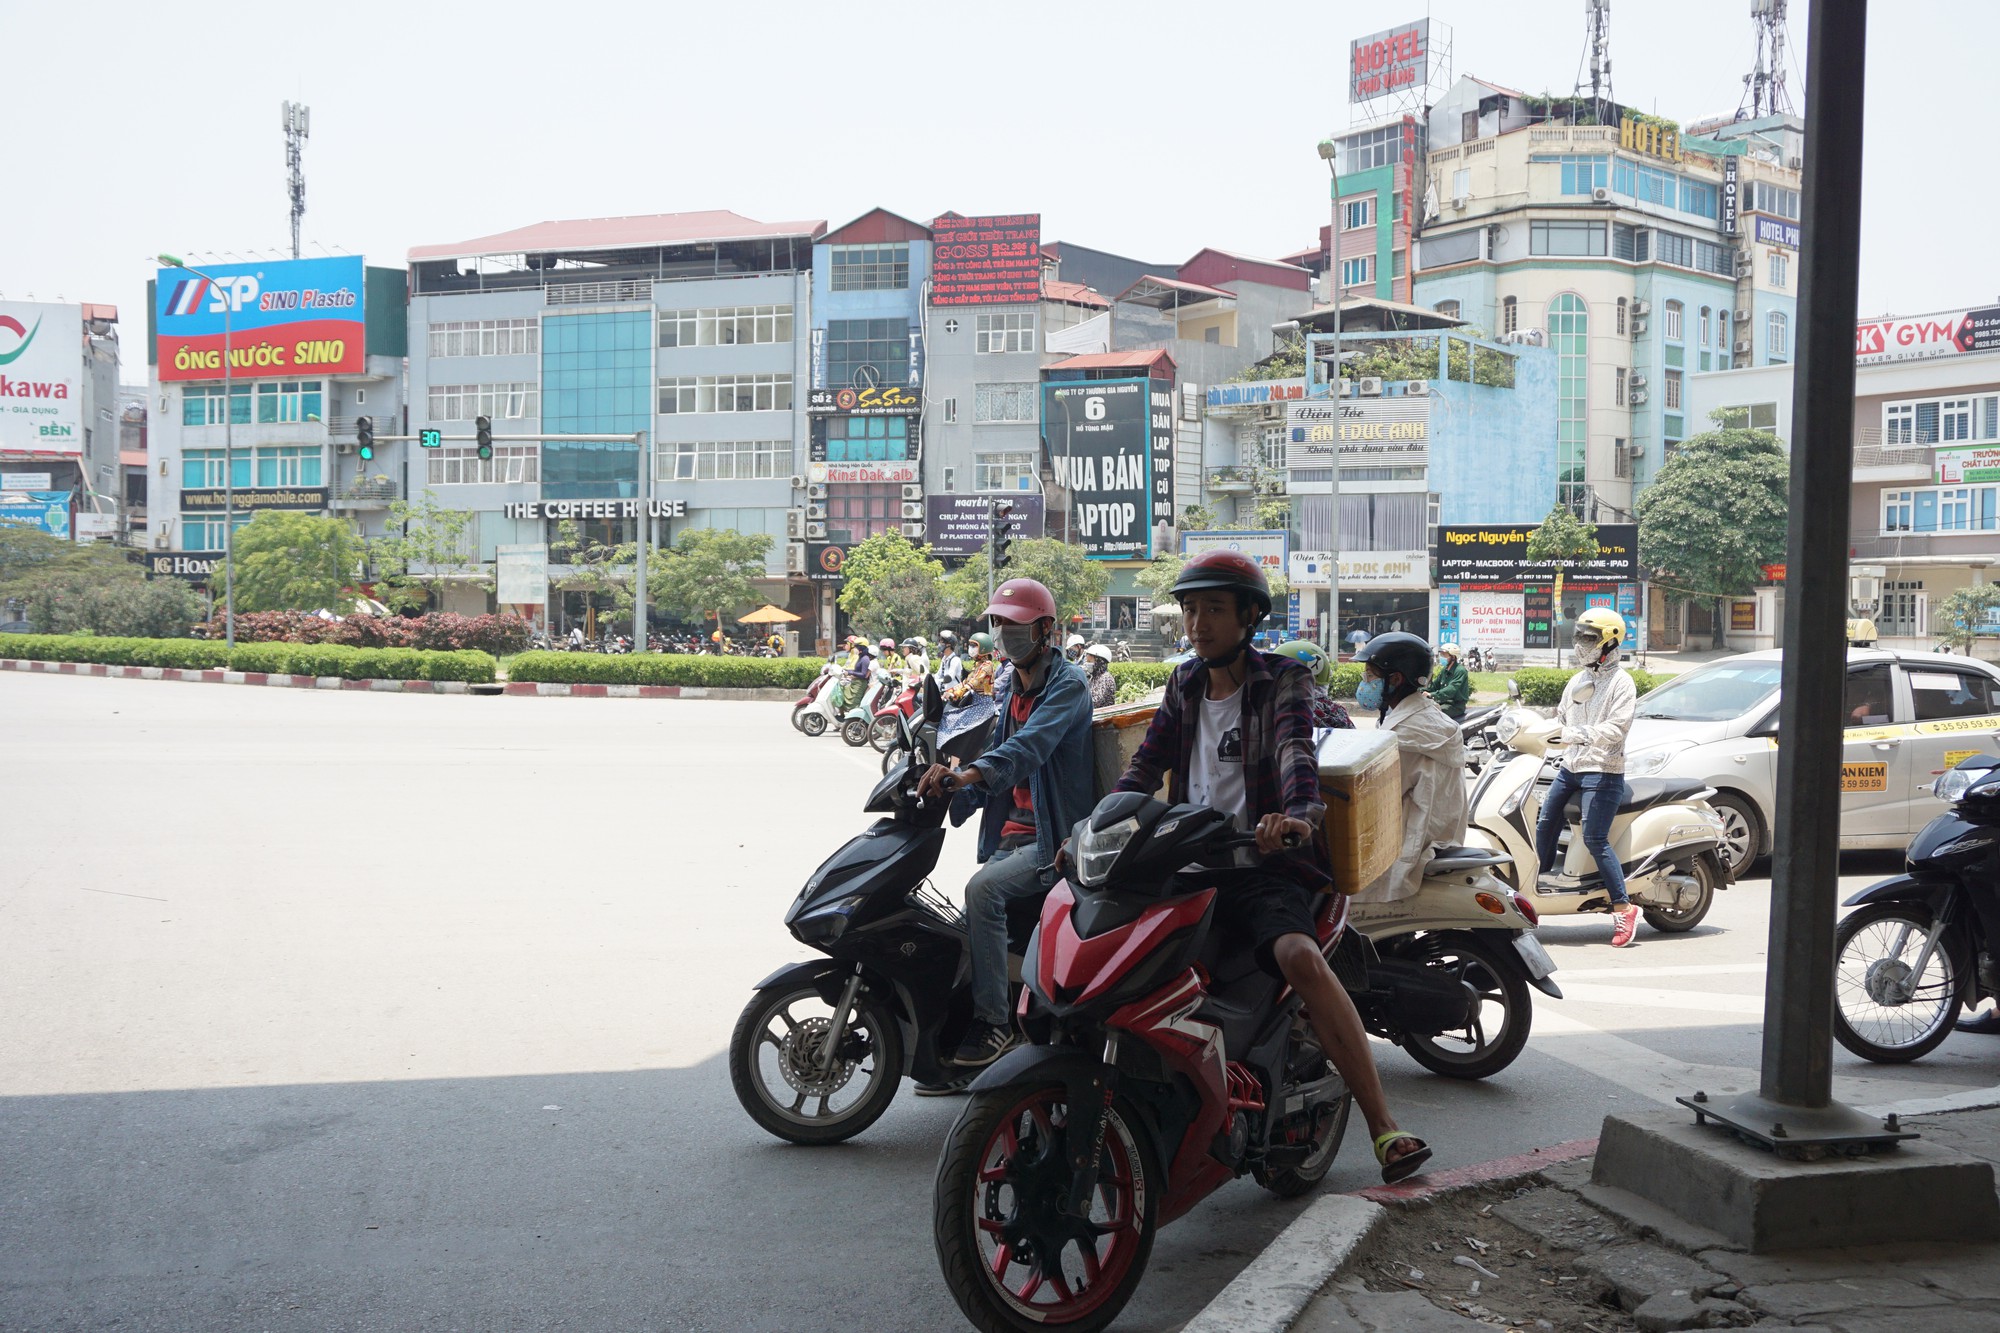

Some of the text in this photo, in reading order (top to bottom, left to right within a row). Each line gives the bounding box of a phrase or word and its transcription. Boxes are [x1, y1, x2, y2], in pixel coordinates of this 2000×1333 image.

[1355, 29, 1423, 77] HOTEL
[1621, 117, 1683, 161] HOTEL
[1403, 126, 1415, 226] HOTEL
[1726, 171, 1736, 232] HOTEL
[1005, 229, 1039, 239] TRANG
[1760, 220, 1784, 242] HOTEL
[936, 244, 989, 259] GOSS
[209, 275, 259, 313] SP
[260, 287, 356, 311] SINO Plastic
[1896, 319, 1953, 346] GYM
[174, 340, 345, 370] ỐNG NƯỚC SINO
[812, 330, 823, 389] UNCLE
[908, 333, 921, 388] TEA
[1898, 351, 1924, 359] GIVE
[825, 394, 833, 403] 2
[1151, 392, 1171, 407] MUA
[1242, 386, 1269, 403] LAPTOP
[1085, 396, 1106, 420] 6
[1152, 412, 1170, 429] BÁN
[422, 431, 440, 447] 30
[1389, 422, 1424, 441] ANH
[1153, 436, 1170, 451] LAP
[1053, 447, 1144, 491] MUA BÁN
[1154, 458, 1170, 473] TOP
[1156, 478, 1169, 494] CŨ
[185, 490, 322, 507] www.honggiamobile.com
[505, 499, 685, 519] THE COFFEE HUSE
[1154, 498, 1171, 516] MỚI
[939, 513, 958, 521] CHỤP
[959, 512, 976, 520] ẢNH
[956, 522, 979, 530] PHÓNG
[1446, 531, 1477, 546] Ngọc
[1478, 529, 1524, 546] Nguyễn
[1602, 546, 1612, 554] Uy
[1263, 555, 1280, 565] 24h
[1383, 562, 1411, 574] ANH
[1442, 559, 1629, 567] LAPTOP MACBOOK IPAD
[1460, 571, 1471, 580] 10
[1472, 605, 1523, 616] SỬA CHỮA
[1942, 719, 1998, 732] 35 59 59 59
[1858, 766, 1885, 777] KIEM
[1847, 779, 1882, 788] 59 59 59
